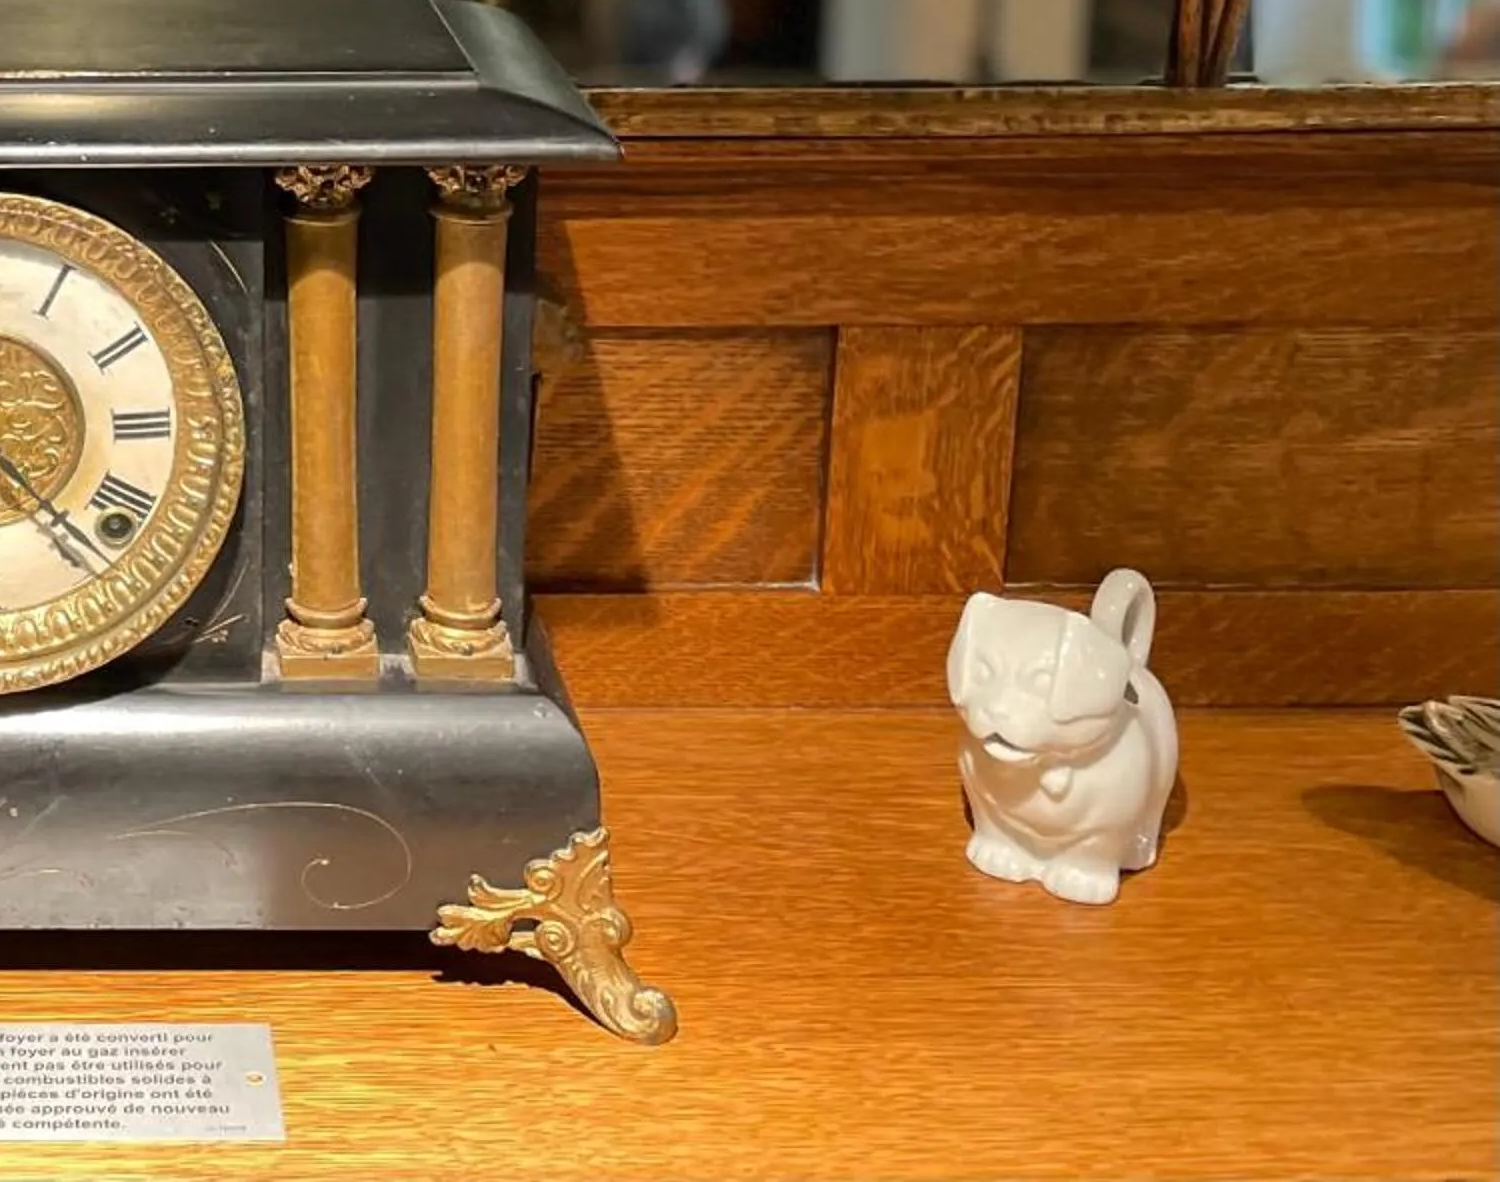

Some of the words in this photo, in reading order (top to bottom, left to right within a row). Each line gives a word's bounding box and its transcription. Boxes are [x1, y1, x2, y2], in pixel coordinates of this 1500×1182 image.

[34, 264, 76, 317] I
[88, 321, 148, 375] II
[113, 407, 171, 442] III
[0, 1032, 43, 1045] foyer
[49, 1034, 59, 1043] a
[65, 1033, 91, 1043] été
[97, 1032, 168, 1043] converti
[173, 1033, 213, 1045] pour
[10, 1046, 55, 1059] foyer
[61, 1048, 82, 1057] au
[87, 1048, 118, 1059] gaz
[124, 1046, 187, 1057] insérer
[34, 1061, 65, 1073] pas
[110, 1059, 175, 1071] utilisés
[181, 1061, 222, 1072] pour
[3, 1074, 125, 1086] combustibles
[131, 1074, 196, 1085] solides
[65, 1087, 145, 1102] d'origine
[150, 1090, 180, 1100] ont
[185, 1088, 213, 1100] été
[31, 1103, 116, 1117] approuvé
[123, 1104, 145, 1115] de
[150, 1105, 230, 1115] nouveau
